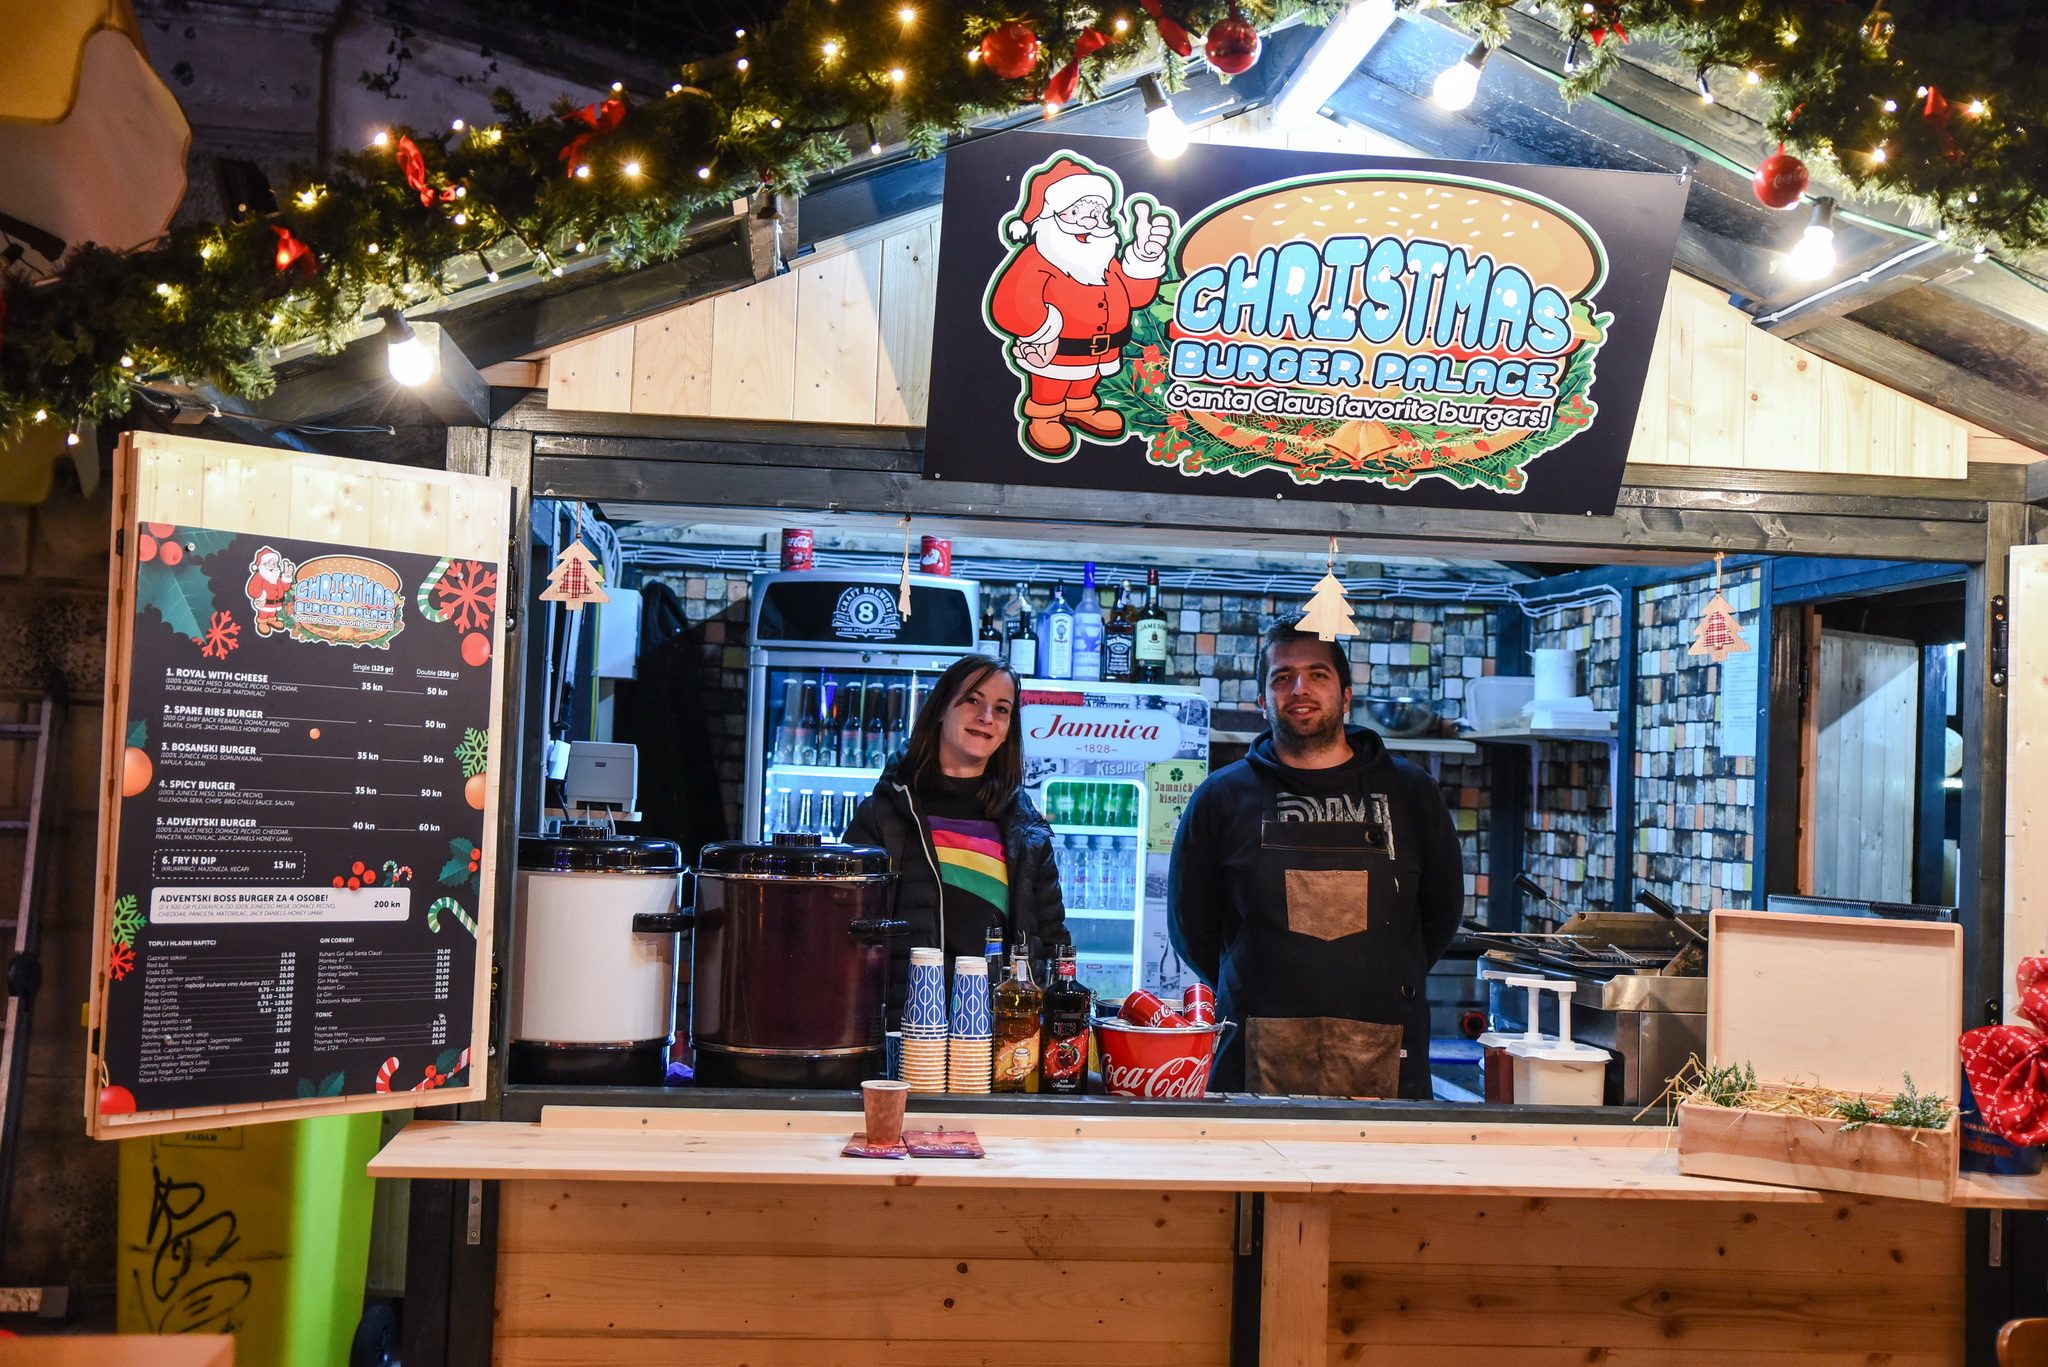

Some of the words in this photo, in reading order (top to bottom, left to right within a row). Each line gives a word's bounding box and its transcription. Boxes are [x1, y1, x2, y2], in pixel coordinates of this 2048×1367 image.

[1176, 236, 1571, 357] CHRISTMAS
[1172, 344, 1363, 388] BURGER
[1372, 357, 1561, 402] PALACE
[1168, 389, 1249, 411] Santa
[1255, 394, 1331, 415] Claus
[1336, 397, 1435, 422] favorite
[1438, 402, 1550, 431] burgers!
[295, 573, 396, 608] CHRISTMAS
[840, 588, 860, 611] CRAFT
[863, 586, 894, 613] BREWERY
[295, 602, 345, 616] BURGER
[347, 606, 394, 621] PALACE
[858, 602, 874, 622] 8
[353, 664, 371, 672] Single
[371, 665, 385, 673] (125
[417, 668, 437, 676] Double
[437, 670, 450, 678] (250
[166, 667, 174, 678] 1.
[175, 668, 206, 680] ROYAL
[208, 670, 232, 681] WITH
[234, 672, 268, 682] CHEESE
[361, 681, 372, 691] 35
[372, 682, 384, 692] kn
[426, 687, 437, 696] 50
[437, 688, 449, 697] kn
[163, 704, 172, 716] 2.
[173, 705, 204, 717] SPARE
[203, 707, 225, 718] RIBS
[226, 708, 264, 720] BURGER
[424, 720, 436, 729] 50
[436, 721, 447, 729] kn
[1029, 713, 1160, 741] Jamnica
[161, 742, 169, 753] 3.
[171, 742, 218, 754] BOSANSKI
[219, 745, 256, 755] BURGER
[357, 751, 368, 761] 35
[368, 752, 380, 761] kn
[423, 754, 434, 763] 50
[434, 755, 445, 764] kn
[1096, 761, 1145, 776] Kiselica
[158, 779, 167, 790] 4.
[169, 779, 196, 791] SPICY
[198, 781, 237, 792] BURGER
[354, 786, 366, 795] 35
[366, 786, 378, 796] kn
[421, 788, 432, 797] 50
[432, 789, 443, 798] kn
[156, 816, 164, 826] 5.
[166, 817, 218, 828] ADVENTSKI
[220, 818, 258, 829] BURGER
[352, 821, 364, 830] 40
[364, 821, 376, 831] kn
[418, 823, 430, 832] 60
[430, 823, 441, 832] kn
[161, 855, 170, 864] 6.
[172, 855, 190, 864] FRY
[191, 856, 198, 865] N
[200, 856, 216, 864] DIP
[273, 860, 285, 869] 15
[284, 860, 297, 870] kn
[159, 894, 210, 902] ADVENTSKI
[213, 894, 236, 902] BOSS
[374, 900, 389, 909] 200
[390, 900, 402, 908] kn
[184, 975, 203, 983] punch!
[333, 1031, 349, 1039] Henry
[1100, 1053, 1211, 1098] Coca-Cola
[185, 1132, 217, 1142] ZADAR
